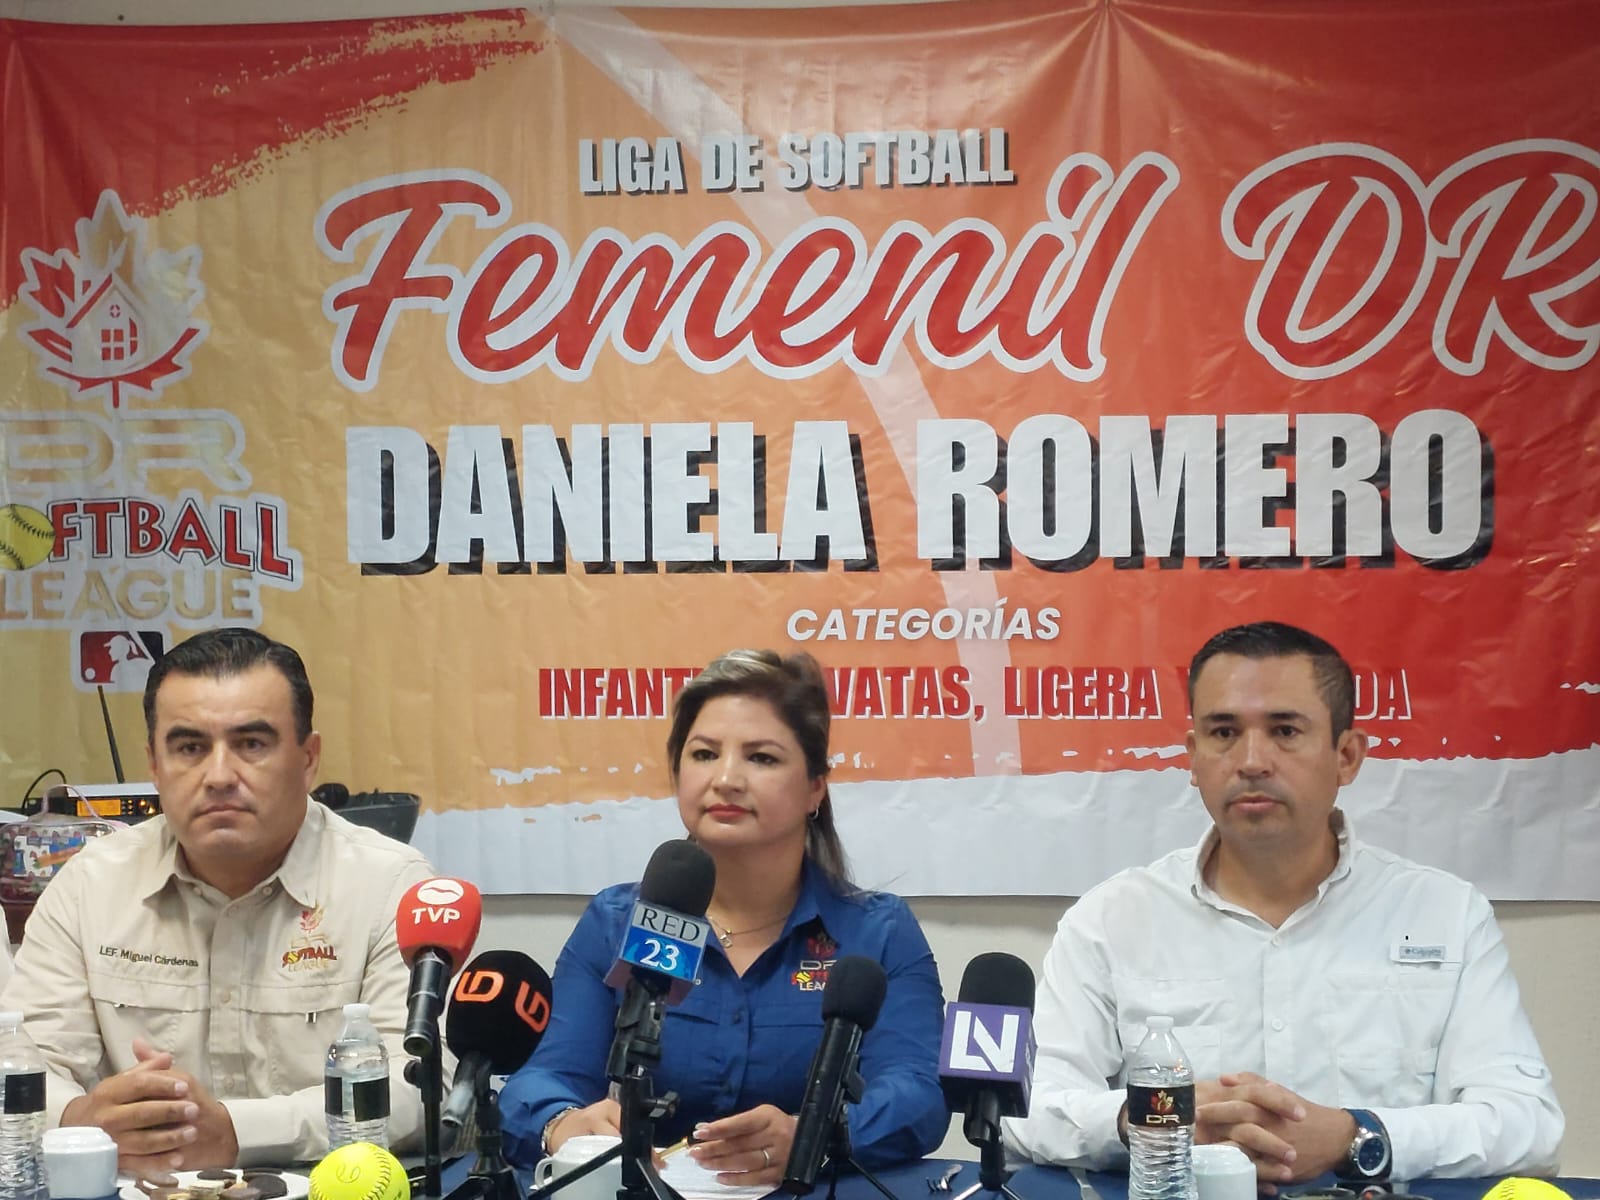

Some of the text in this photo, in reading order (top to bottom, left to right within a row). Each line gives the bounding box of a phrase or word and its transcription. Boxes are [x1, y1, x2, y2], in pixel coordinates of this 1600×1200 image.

[578, 128, 1017, 196] LIGA DE SOFTBALL
[322, 138, 1600, 392] Femenil DR
[346, 409, 1494, 575] DANIELA ROMERO
[0, 568, 256, 622] LEAGUE
[787, 597, 1061, 641] CATEGORÍAS
[538, 667, 703, 719] INFANT
[824, 666, 988, 722] VATAS,
[1004, 667, 1162, 719] LIGERA
[412, 907, 461, 925] TVP
[640, 907, 700, 942] RED
[120, 948, 153, 963] Miguel
[640, 939, 680, 971] 23
[949, 1010, 1020, 1073] LN
[1146, 1114, 1180, 1124] DR
